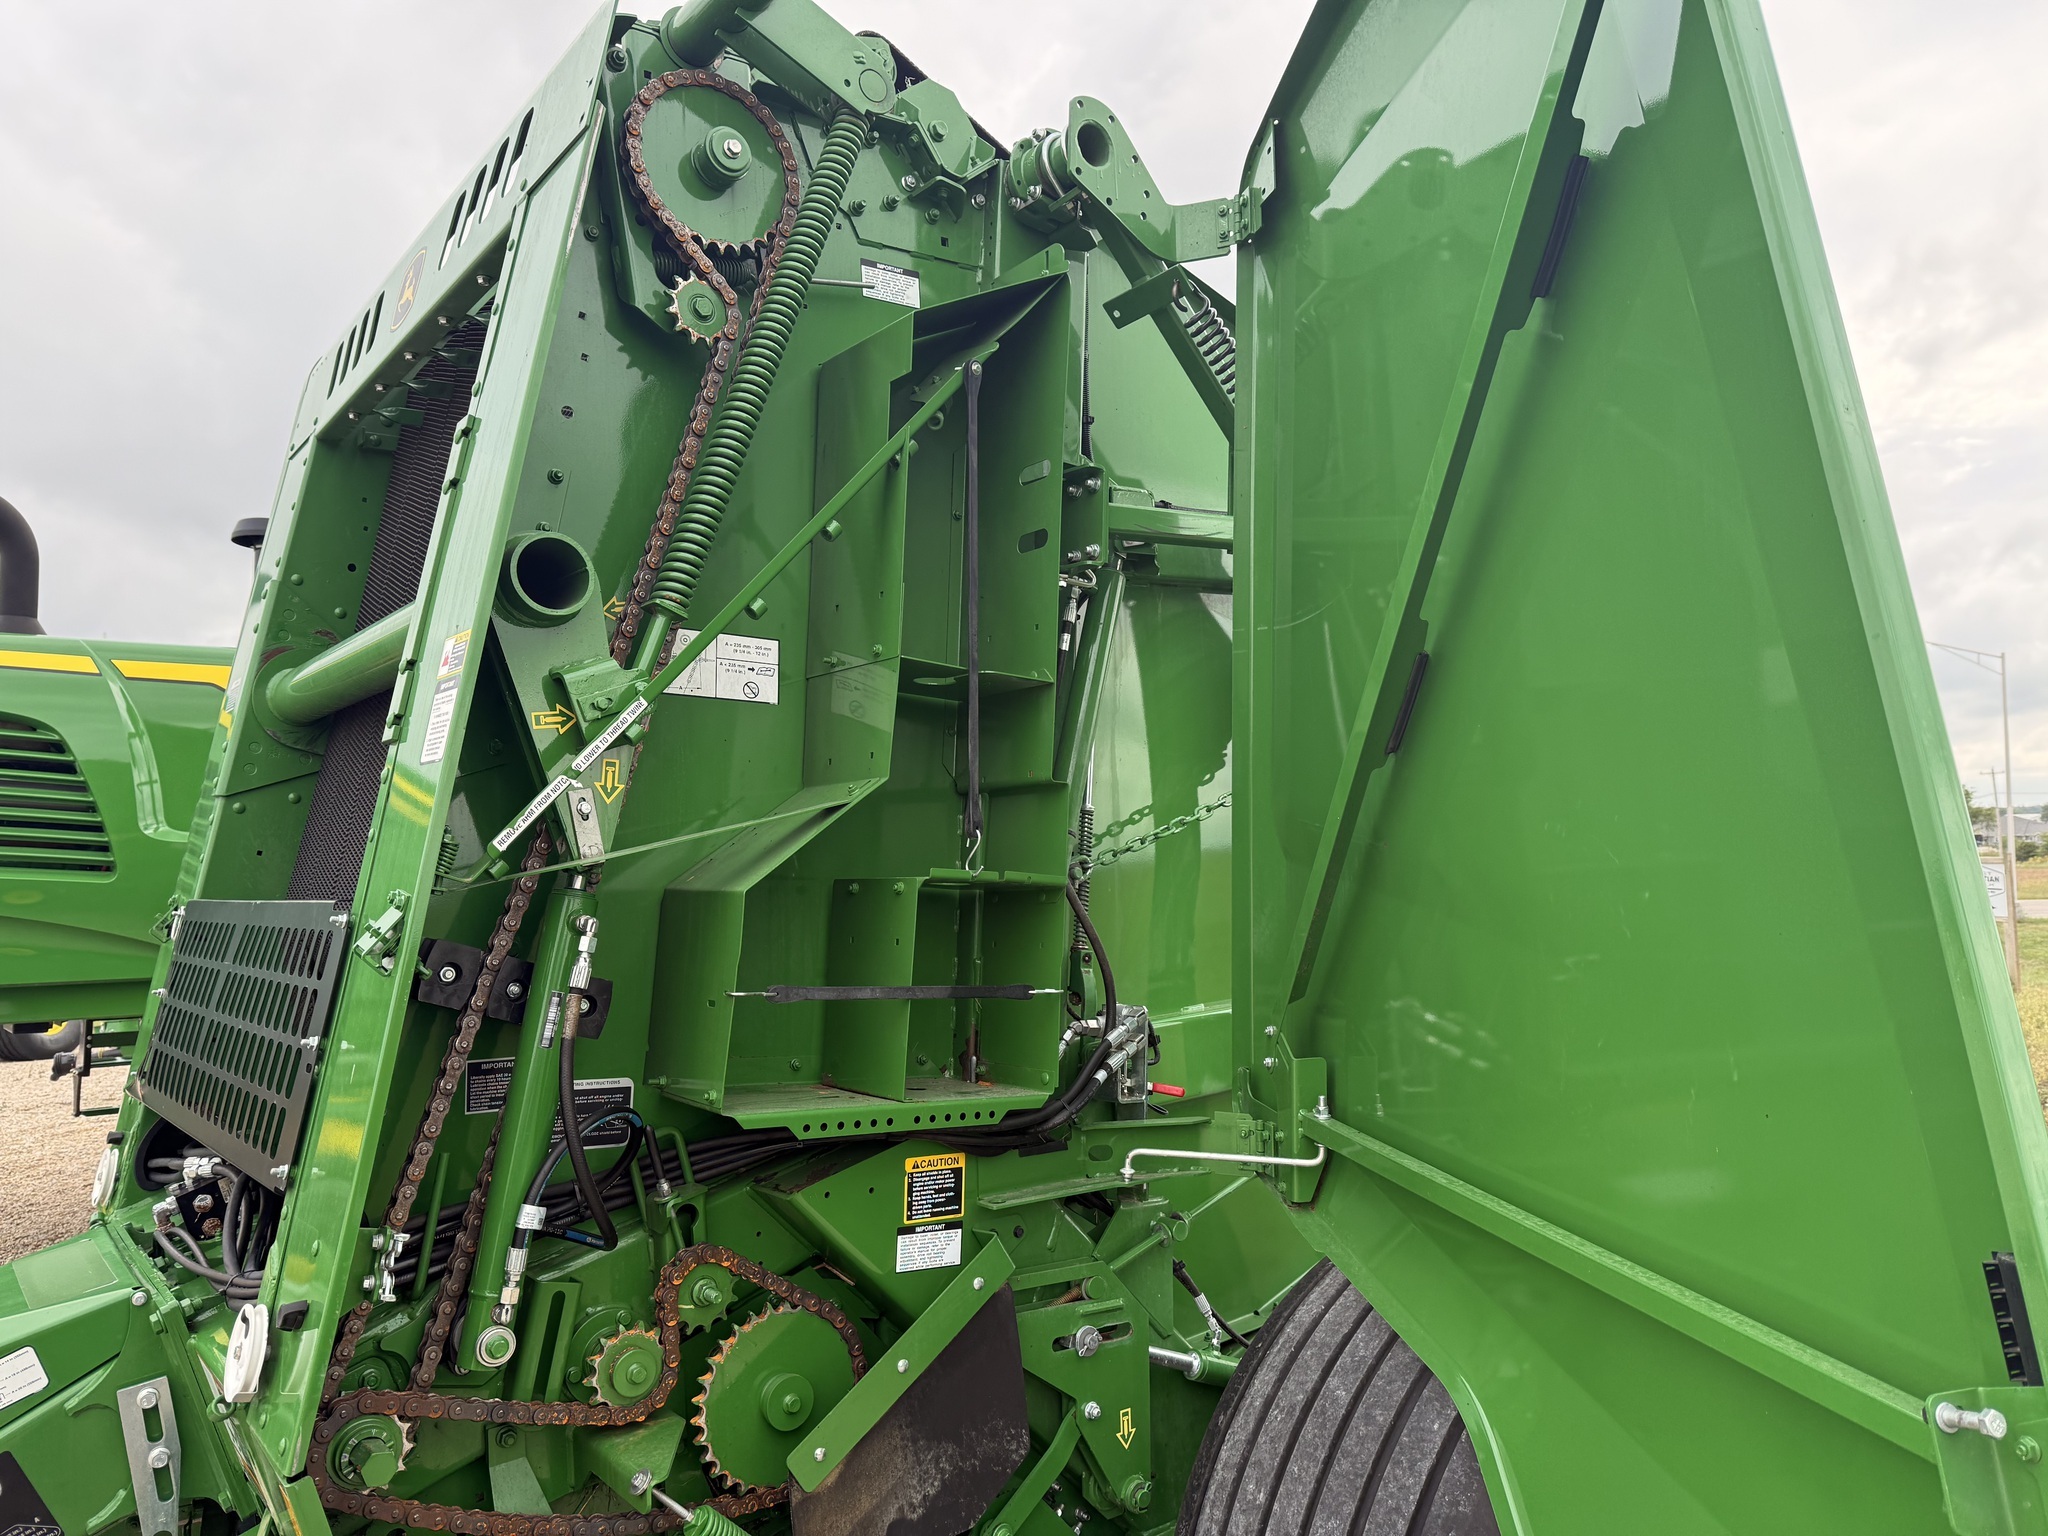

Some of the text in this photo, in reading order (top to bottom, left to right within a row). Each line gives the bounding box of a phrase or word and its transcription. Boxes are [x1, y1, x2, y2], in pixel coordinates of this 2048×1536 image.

[876, 262, 904, 274] IMPORTANT
[534, 792, 552, 811] FROM
[580, 744, 602, 766] LOWER
[600, 736, 608, 746] TO
[607, 716, 628, 739] THREAD
[626, 700, 644, 719] TWINE
[920, 1156, 960, 1168] CAUTION
[916, 1224, 946, 1232] IMPORTANT
